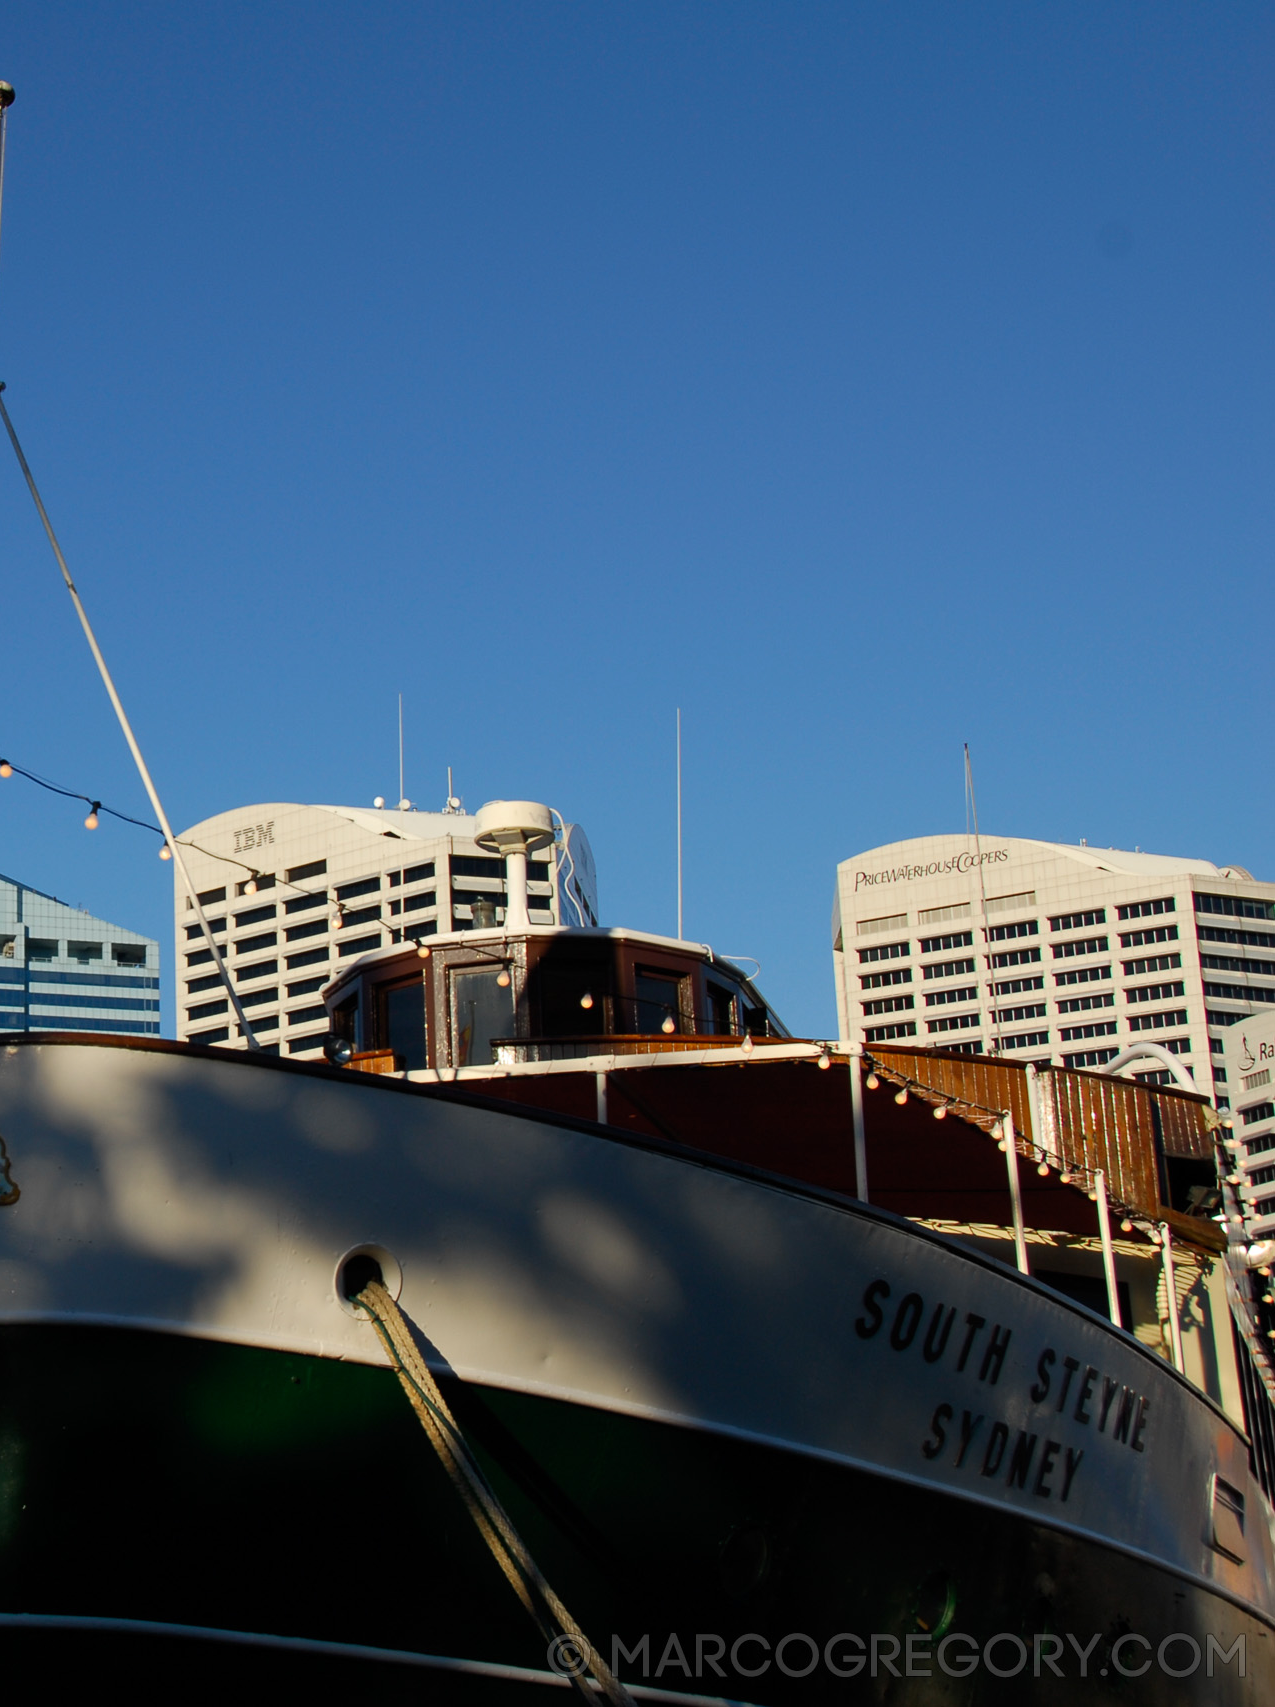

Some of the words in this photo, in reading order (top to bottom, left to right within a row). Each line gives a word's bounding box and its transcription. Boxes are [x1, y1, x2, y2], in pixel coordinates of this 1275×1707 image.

[234, 821, 274, 853] IBM
[855, 1279, 1012, 1385] SOUTH
[1030, 1349, 1150, 1452] STEYNE
[922, 1403, 1083, 1502] SYDNEY
